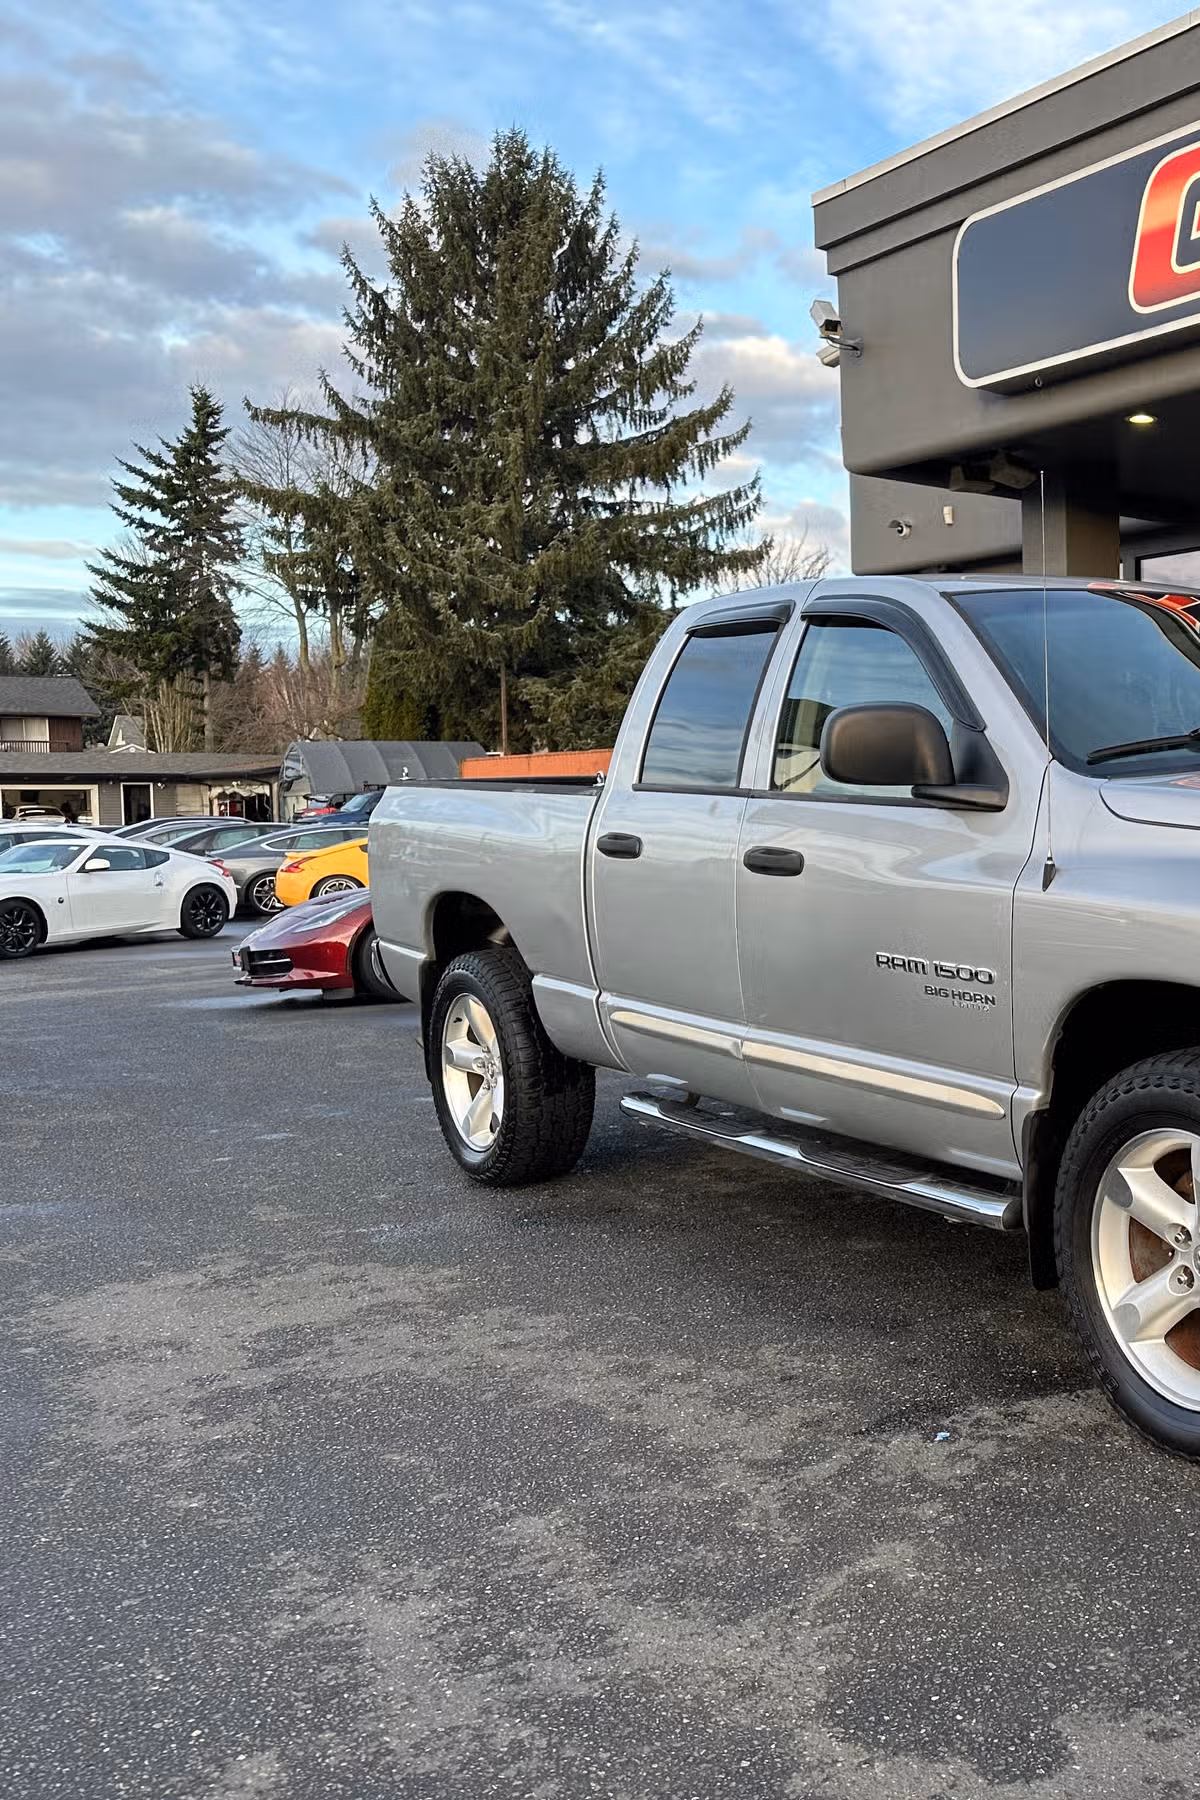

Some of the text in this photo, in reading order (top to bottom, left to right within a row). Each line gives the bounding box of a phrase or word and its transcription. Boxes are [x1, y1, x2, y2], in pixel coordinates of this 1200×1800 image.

[875, 951, 997, 985] RAM 1500
[924, 984, 997, 1007] BIG HORN
